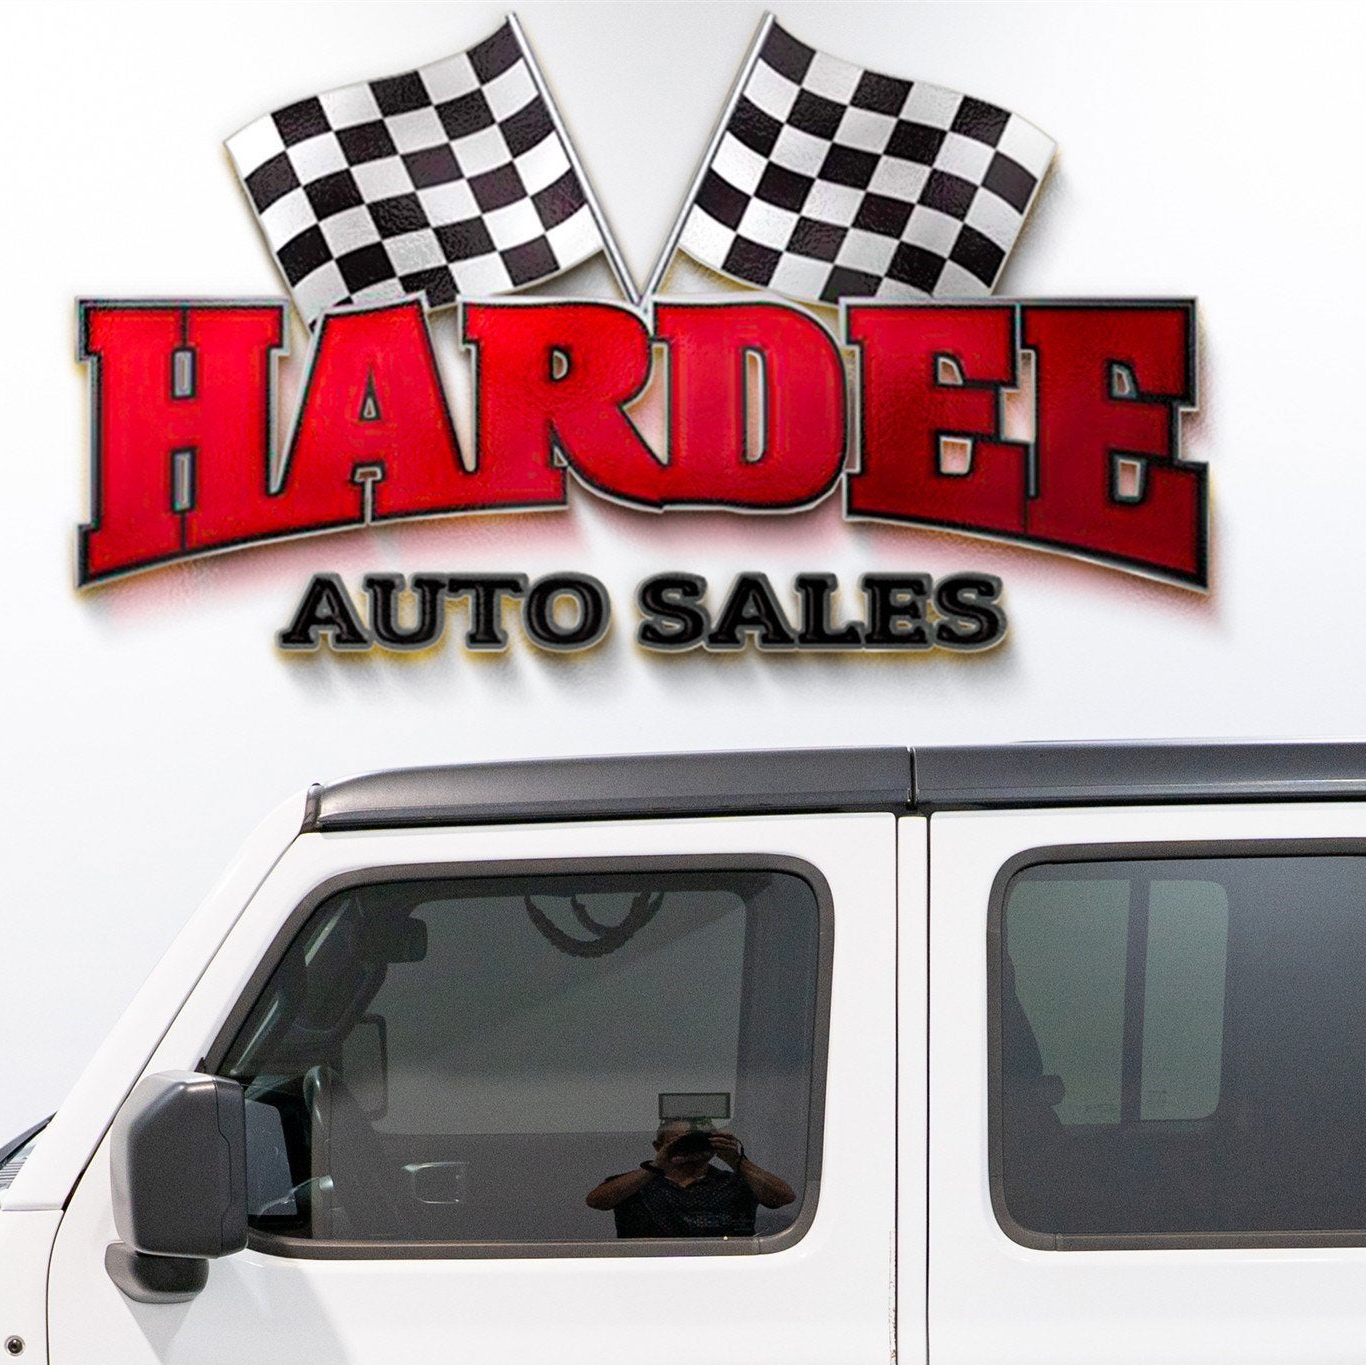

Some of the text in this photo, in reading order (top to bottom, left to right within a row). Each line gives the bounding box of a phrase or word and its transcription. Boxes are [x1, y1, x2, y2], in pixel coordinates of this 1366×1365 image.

[77, 293, 1211, 590] HARDEE
[278, 571, 1008, 653] AUTO SALES
